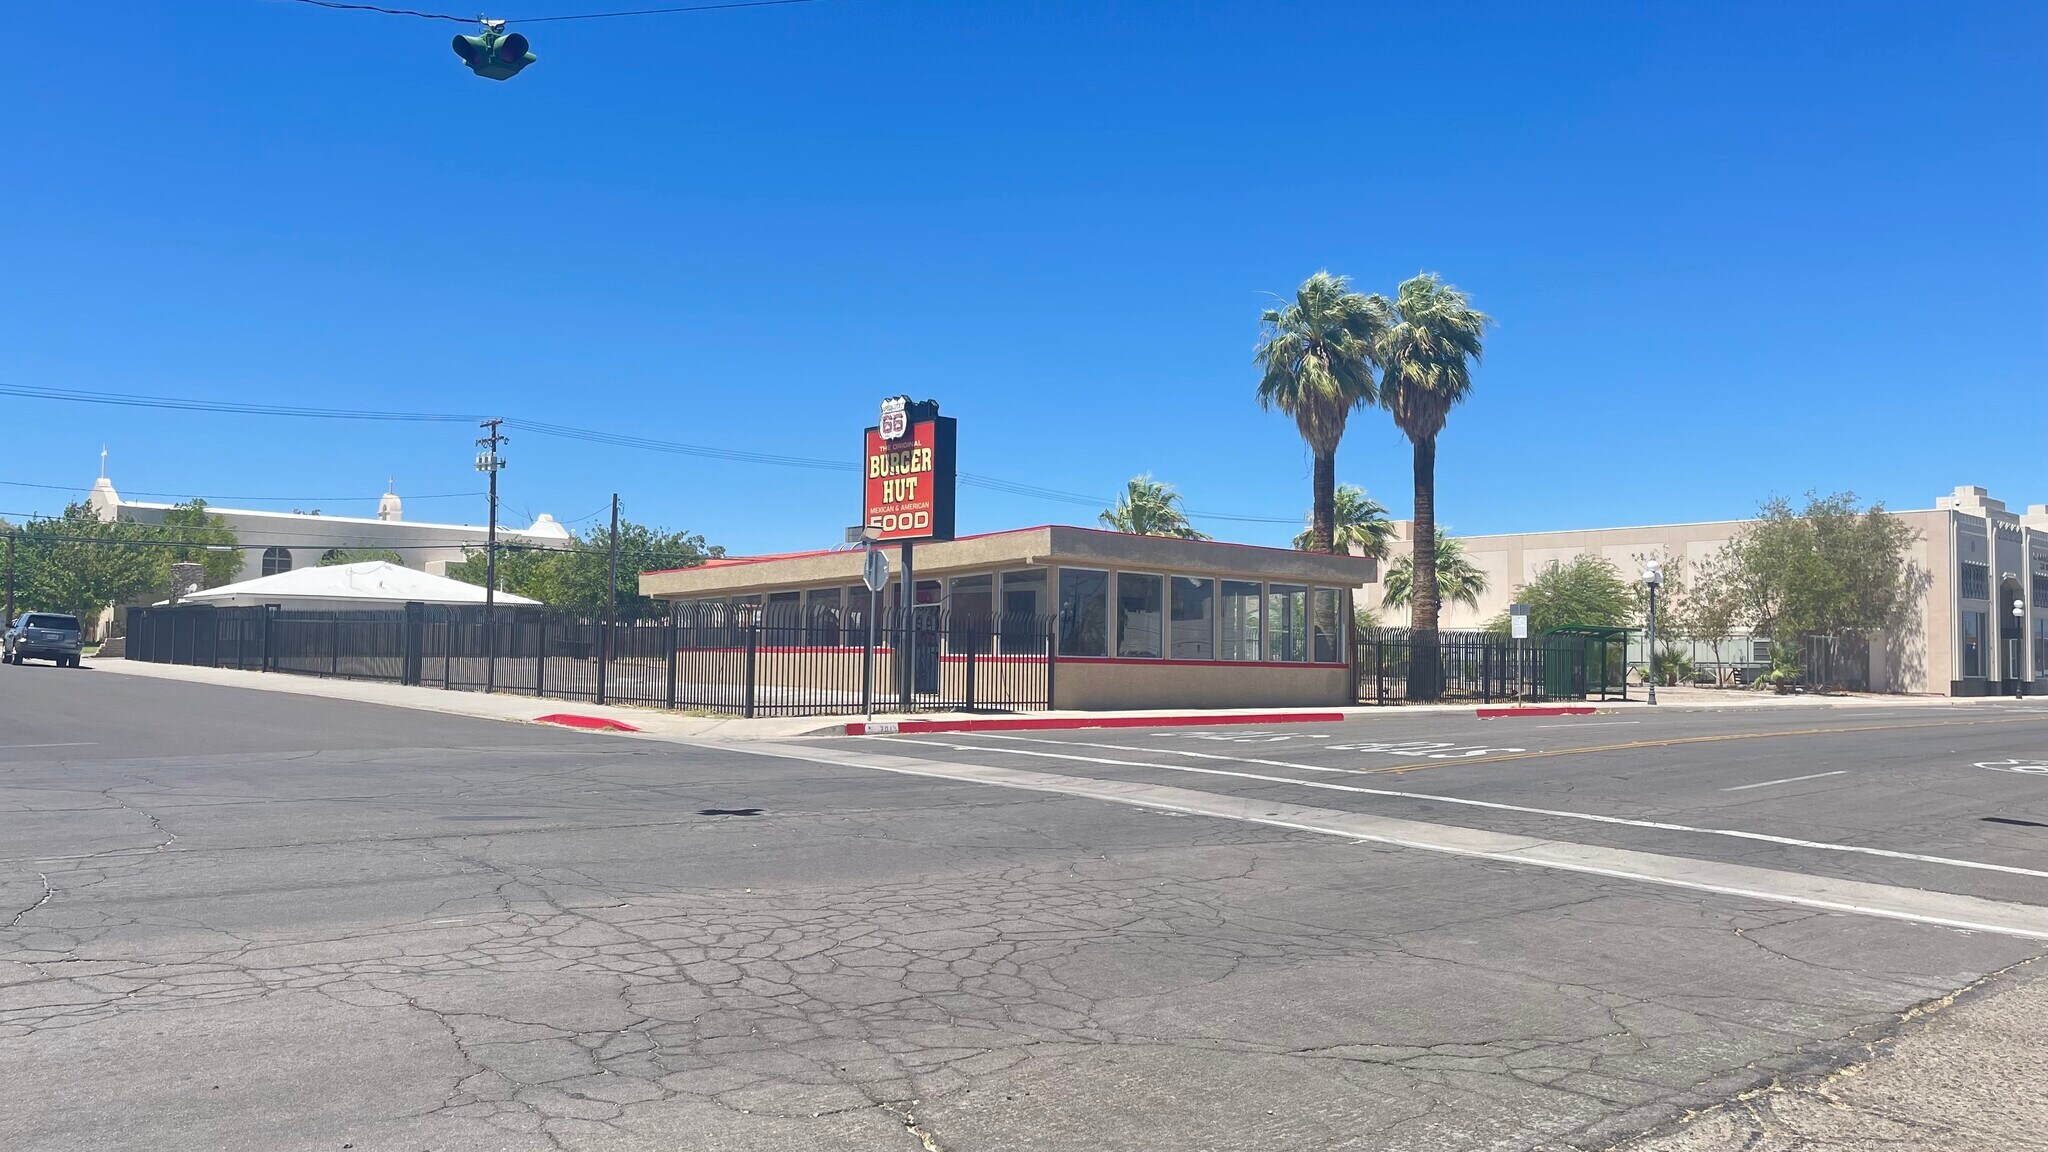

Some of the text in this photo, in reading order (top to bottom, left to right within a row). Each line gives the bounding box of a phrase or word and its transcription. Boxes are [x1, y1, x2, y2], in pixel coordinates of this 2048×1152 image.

[883, 412, 903, 433] 66
[892, 440, 922, 450] ORIGINAL
[869, 447, 932, 479] BURGER
[882, 476, 918, 504] HUT
[870, 501, 930, 514] MEXICAN & AMERICAN
[870, 511, 929, 532] FOOD
